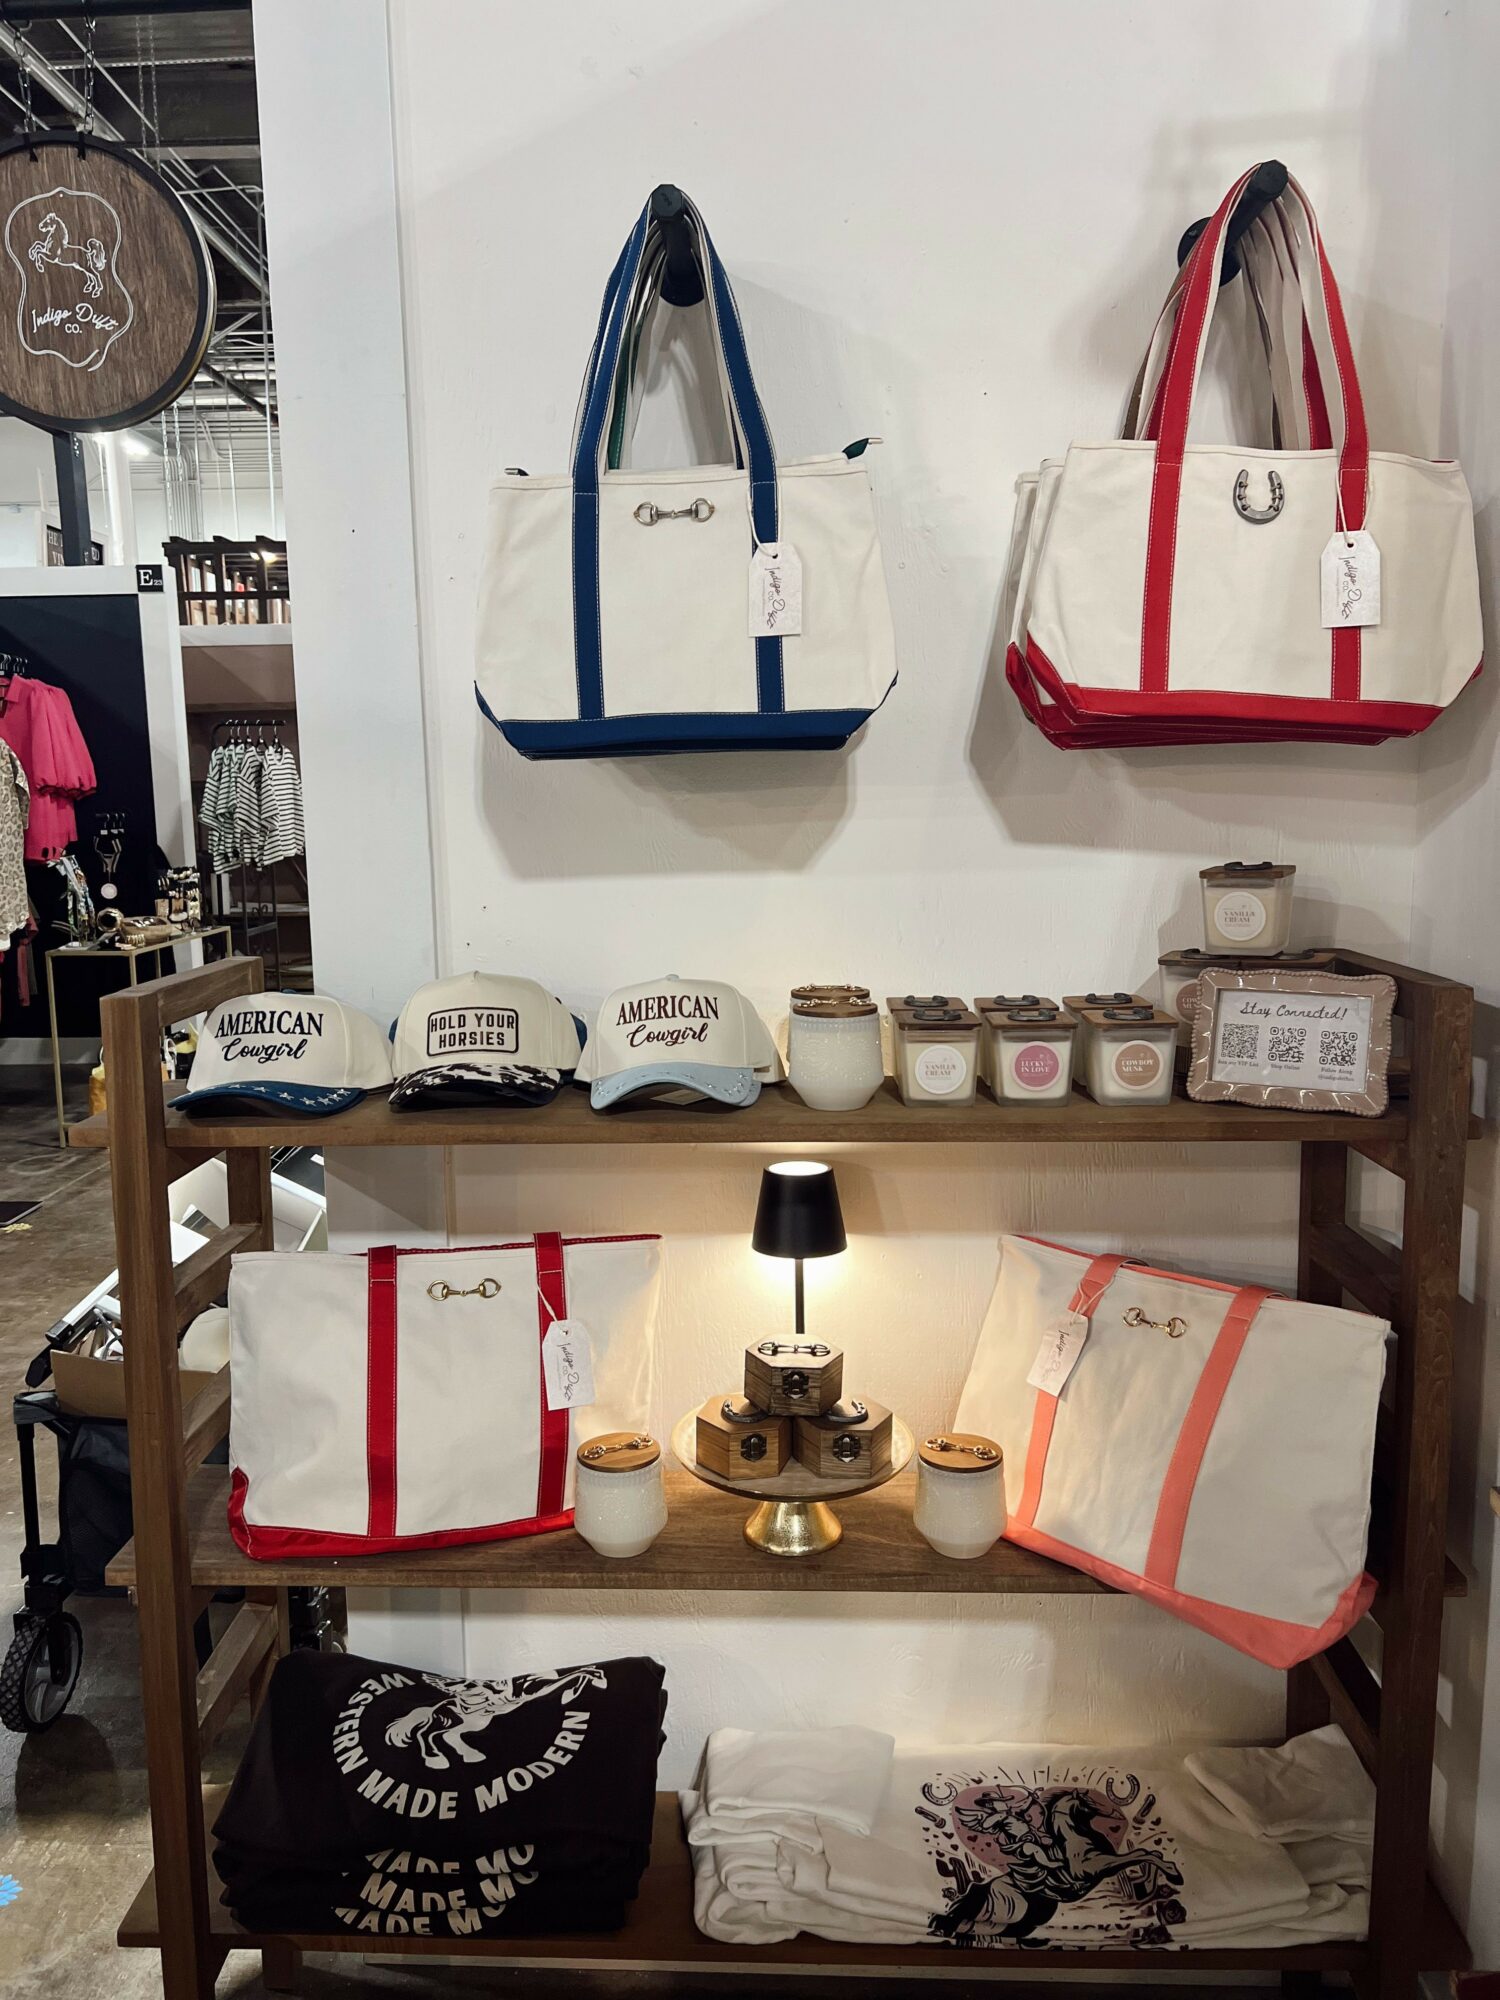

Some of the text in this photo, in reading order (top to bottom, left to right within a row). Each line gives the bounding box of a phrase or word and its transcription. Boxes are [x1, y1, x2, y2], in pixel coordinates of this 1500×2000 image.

[31, 303, 119, 333] Indigo Drift
[64, 323, 83, 334] CO.
[430, 1012, 515, 1034] HOLD YOUR
[616, 994, 720, 1026] AMERICAN
[1240, 1001, 1348, 1020] Stay Connected!
[215, 1009, 324, 1039] AMERICAN
[626, 1022, 709, 1048] Cowgirl
[221, 1038, 309, 1064] Cowgirl
[438, 1030, 506, 1049] HORSIES
[332, 1672, 591, 1820] WESTERN MADE MODERN
